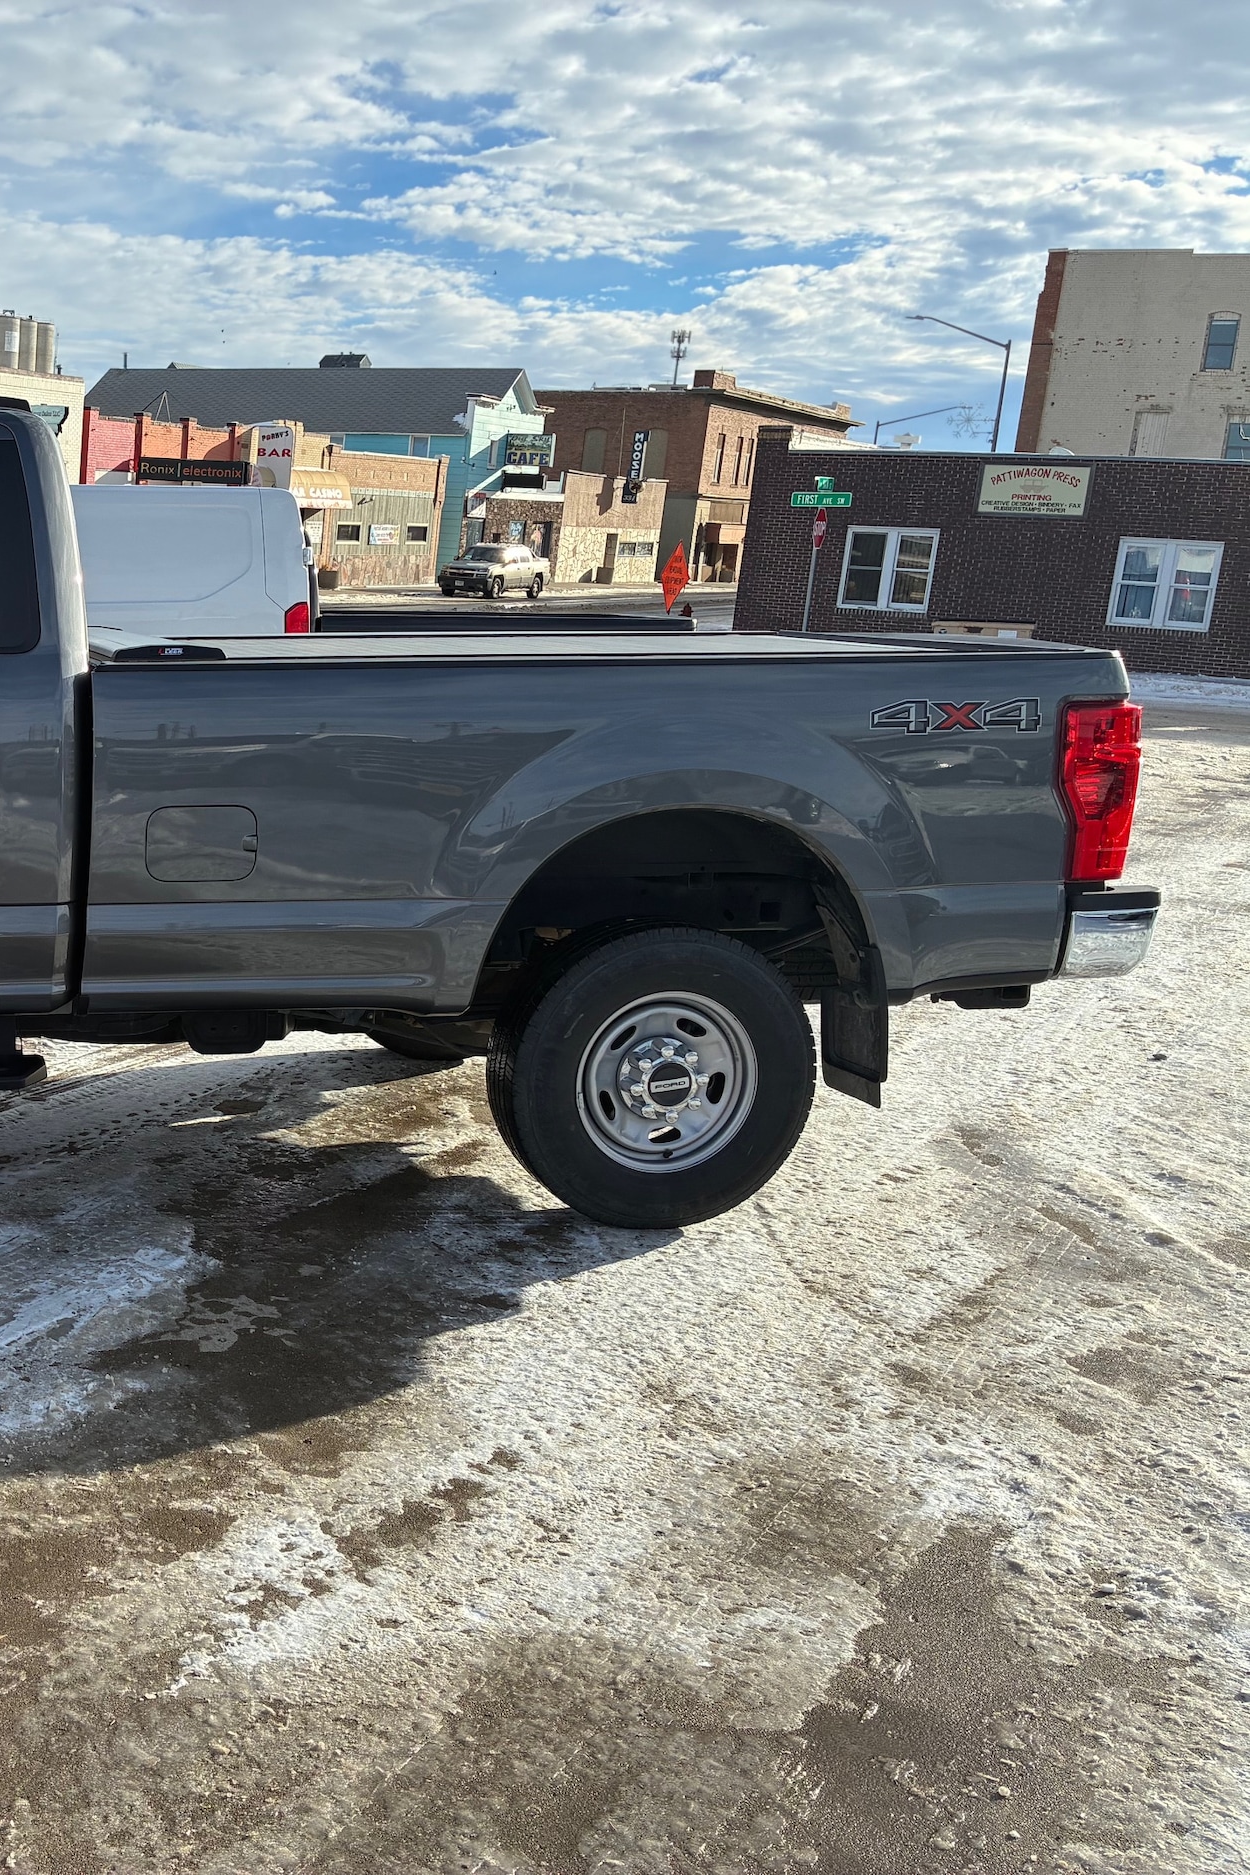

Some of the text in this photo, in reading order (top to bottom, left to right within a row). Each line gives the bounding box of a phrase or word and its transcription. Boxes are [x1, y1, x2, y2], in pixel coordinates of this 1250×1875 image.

[257, 447, 292, 457] BAR
[631, 432, 644, 479] MOOSE
[507, 452, 549, 465] CAFE
[140, 462, 242, 478] Ronix electronix
[990, 467, 1081, 488] PATTIWAGON PRESS
[309, 487, 343, 499] CASINO
[1011, 494, 1052, 502] PRINTING
[797, 494, 846, 505] FIRST AVE SW
[813, 521, 827, 536] STOP
[655, 1081, 686, 1090] FORD
